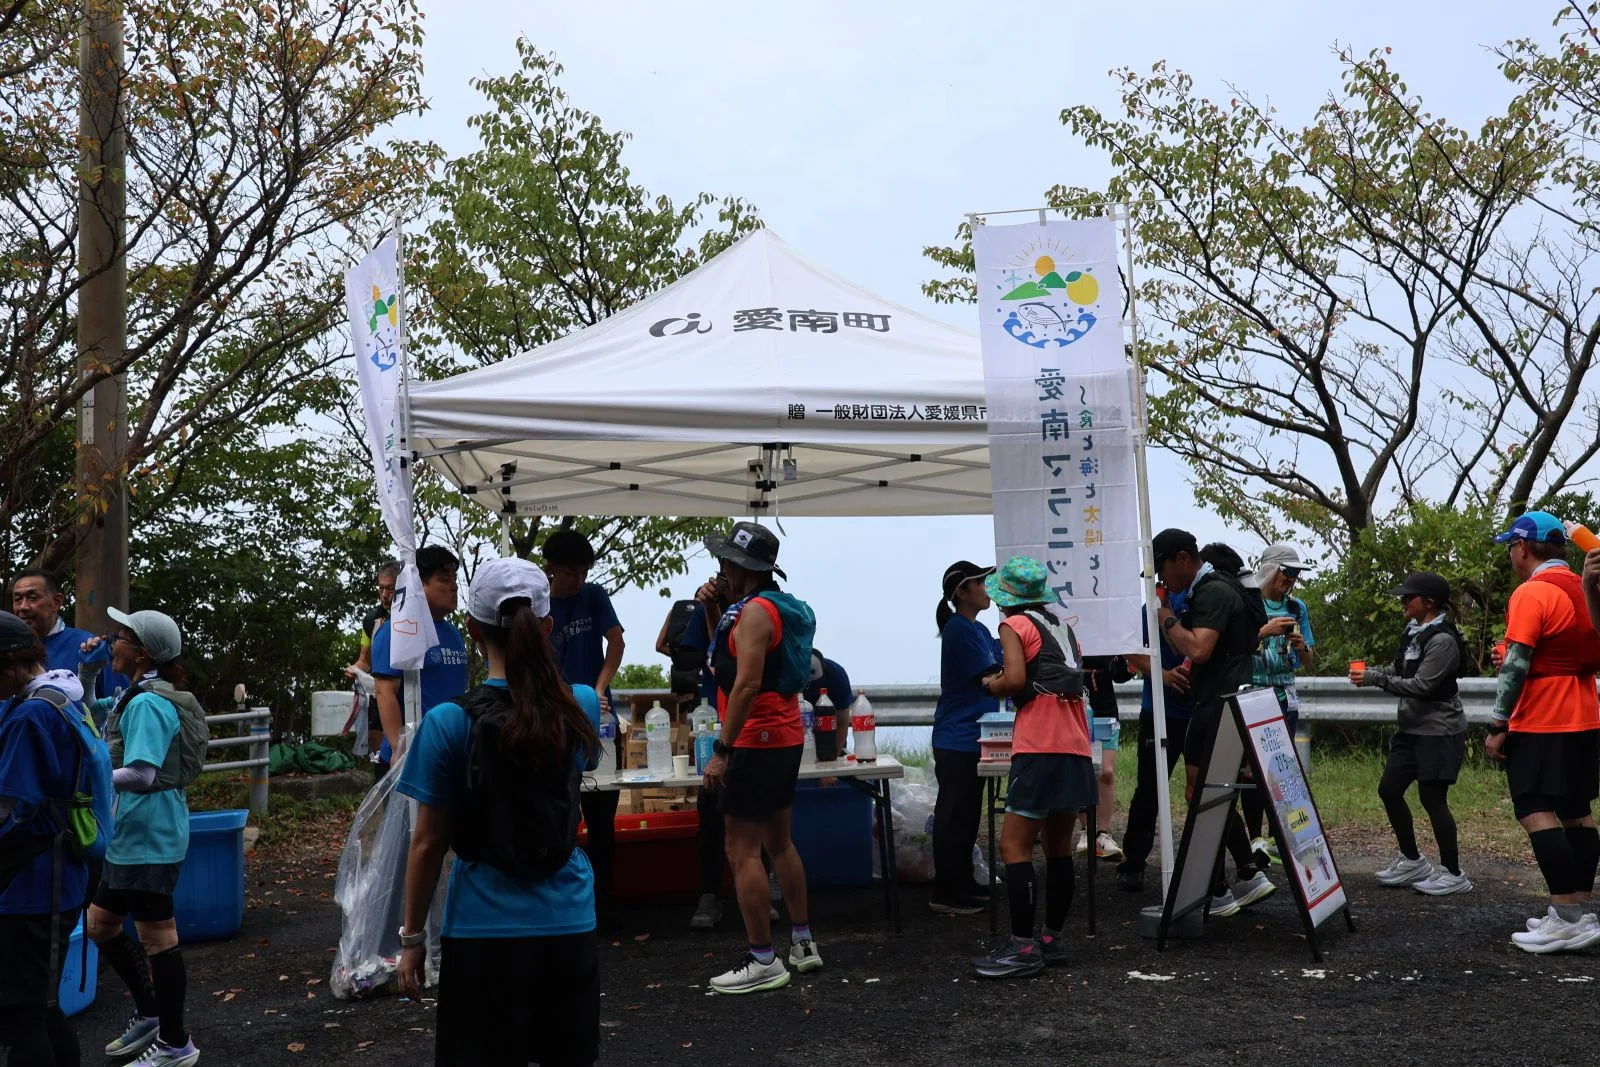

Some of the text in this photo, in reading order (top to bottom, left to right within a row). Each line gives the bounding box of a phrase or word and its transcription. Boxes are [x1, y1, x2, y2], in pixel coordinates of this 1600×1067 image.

[733, 307, 891, 334] 愛南町
[787, 403, 806, 421] 贈
